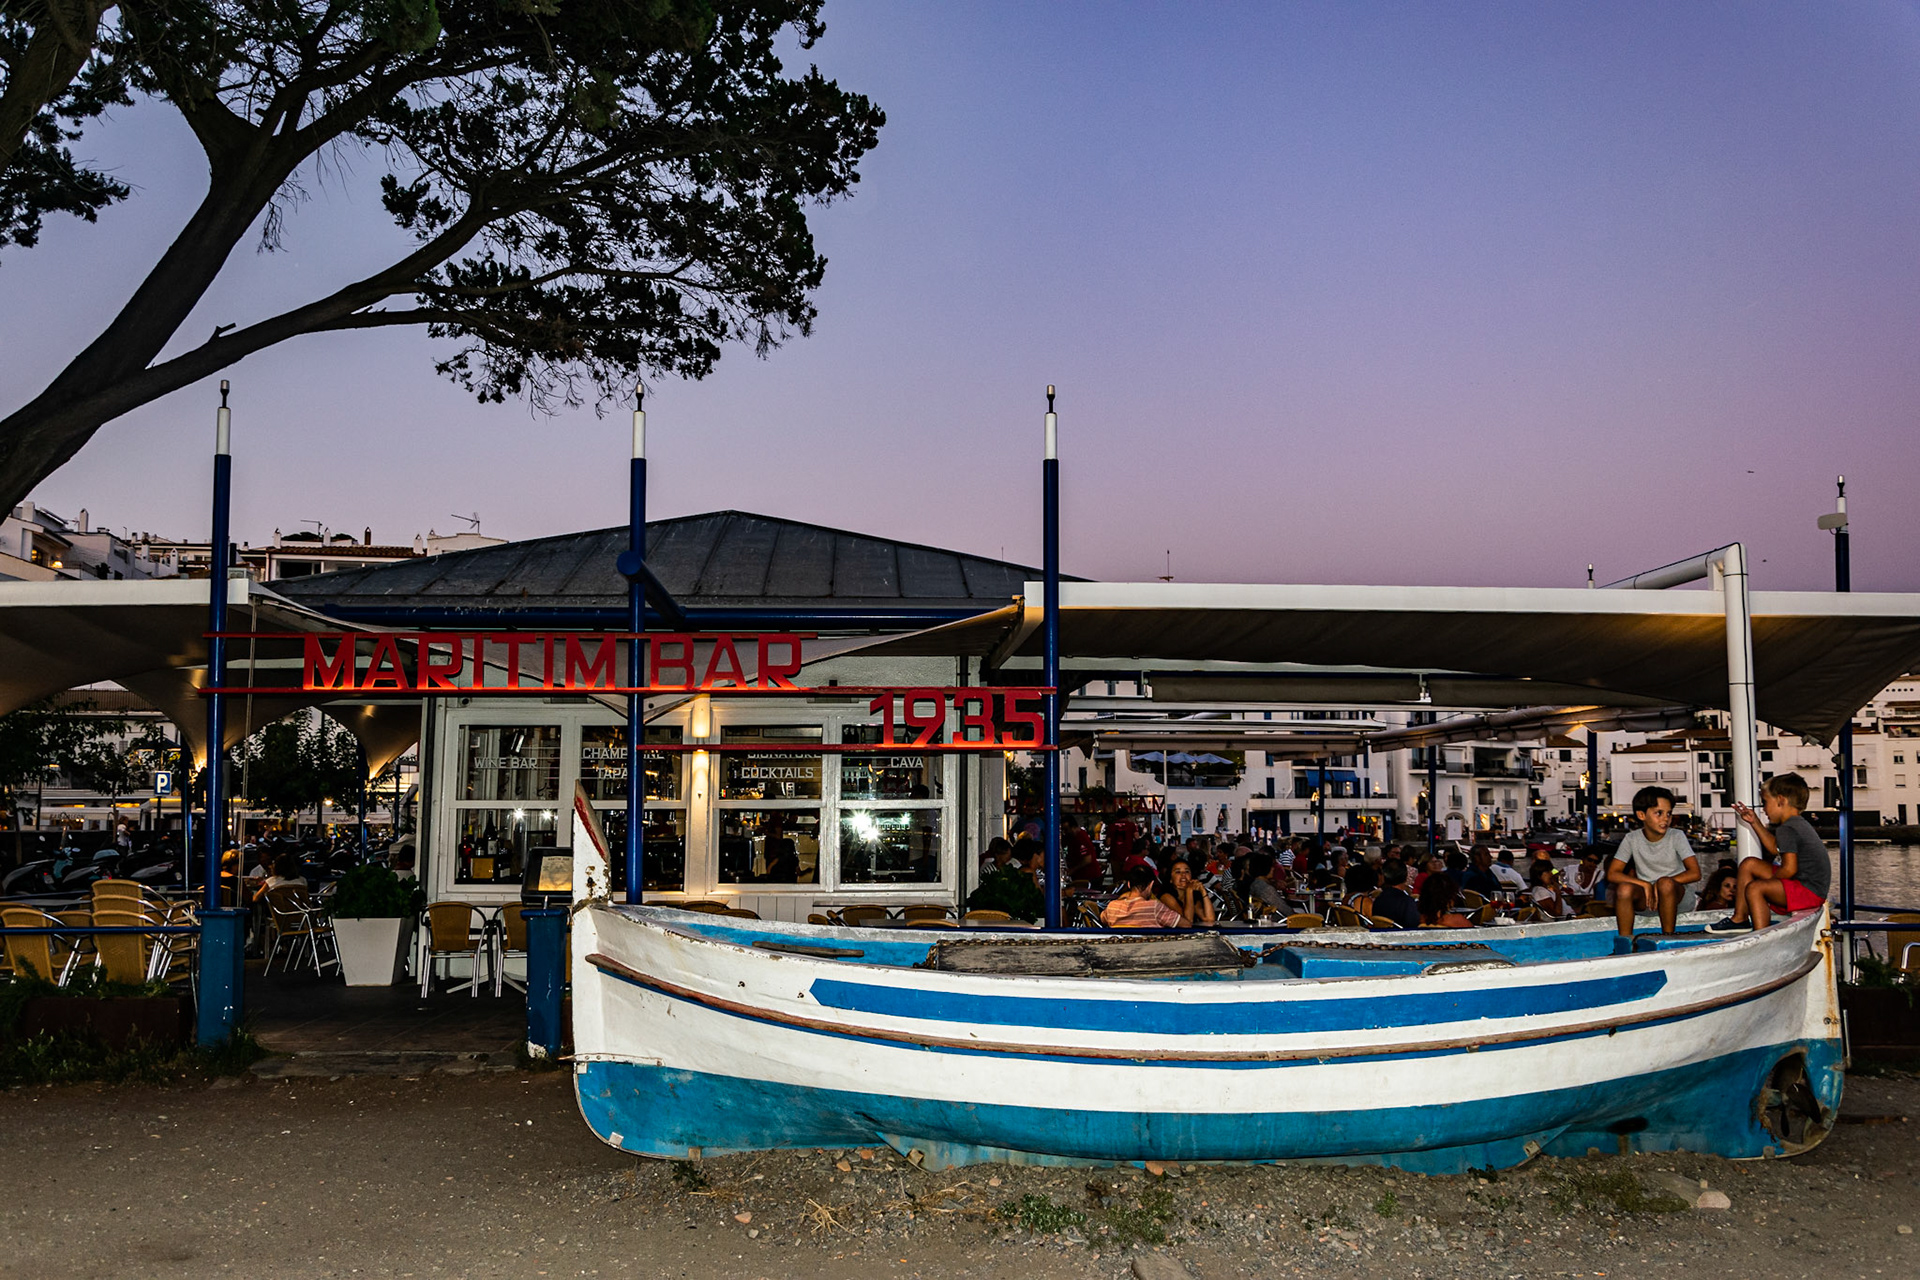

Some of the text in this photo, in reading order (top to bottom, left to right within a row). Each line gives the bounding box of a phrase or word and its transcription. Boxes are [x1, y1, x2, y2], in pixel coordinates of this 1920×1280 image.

[302, 632, 803, 690] MARITIM BAR
[869, 689, 1045, 748] 1935
[473, 757, 538, 769] WINE BAR
[890, 756, 924, 768] CAVA
[598, 767, 628, 779] TAPA
[741, 767, 814, 779] COCKTAILS
[156, 773, 168, 793] P
